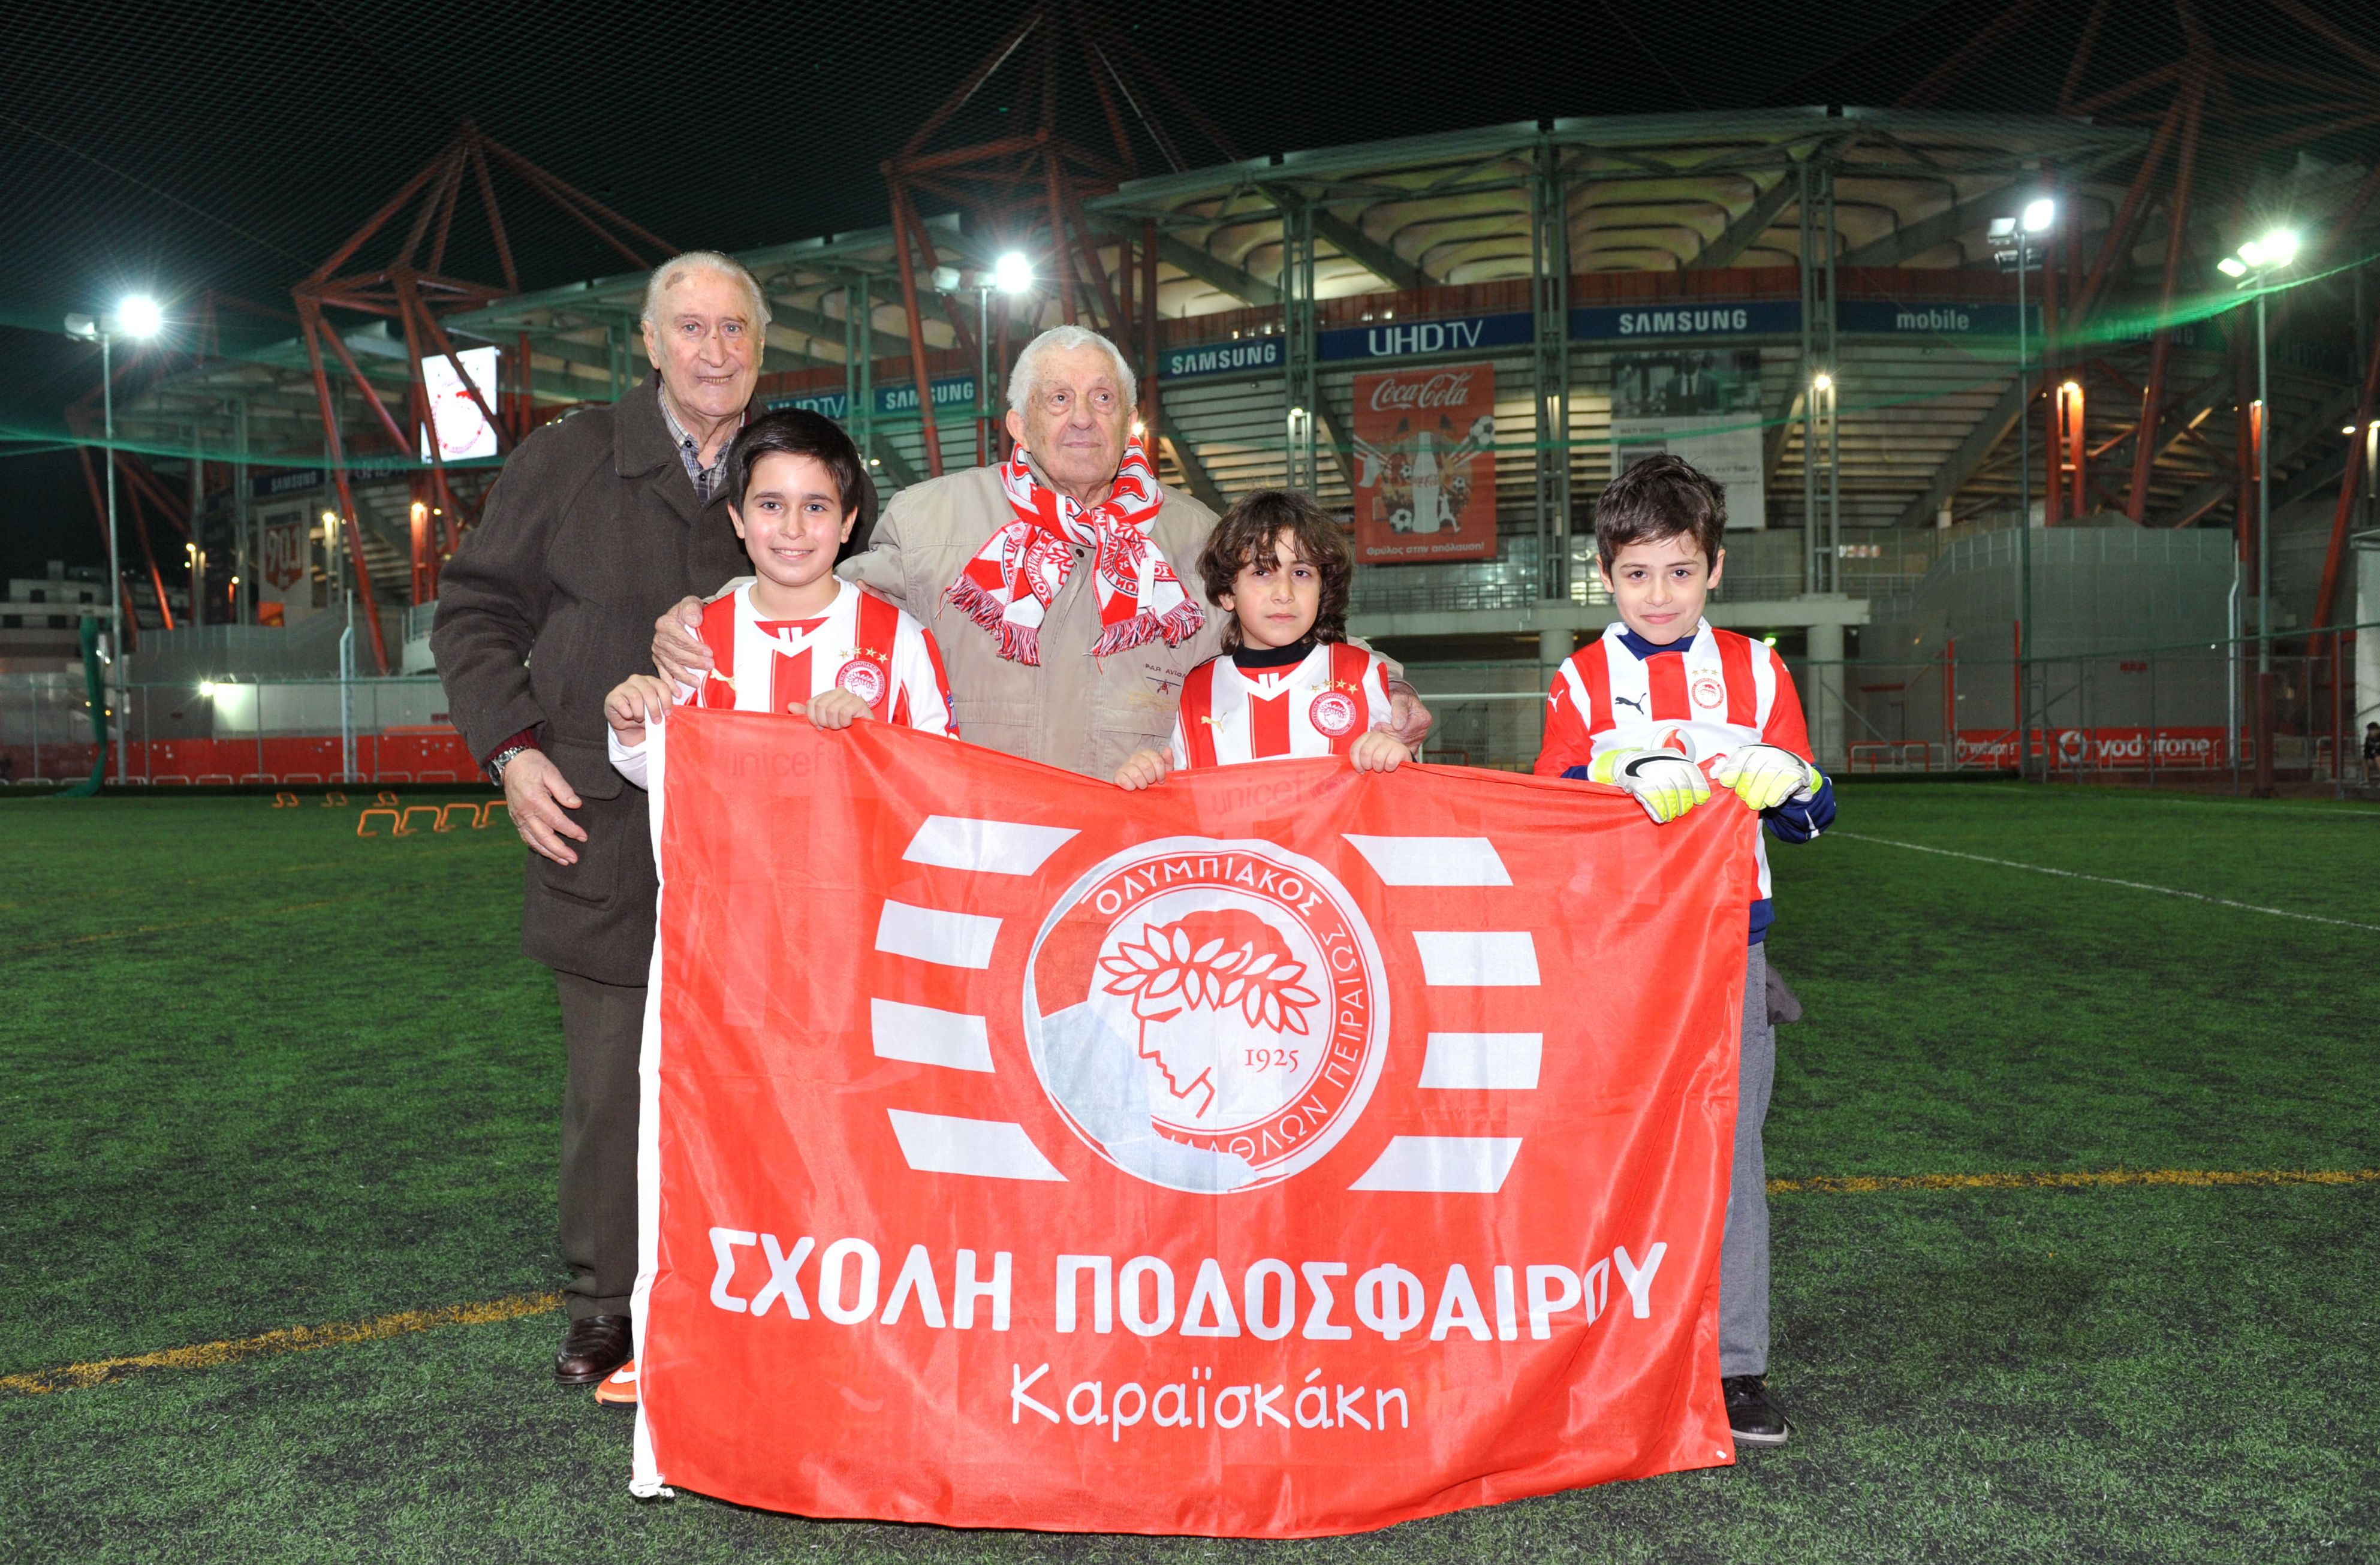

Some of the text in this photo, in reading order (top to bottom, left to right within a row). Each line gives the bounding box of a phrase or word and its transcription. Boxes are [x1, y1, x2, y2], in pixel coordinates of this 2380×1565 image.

[1619, 308, 1748, 334] SAMSUNG
[1896, 309, 1969, 331] mobile
[1171, 343, 1276, 375] SAMSUNG
[1145, 664, 1161, 672] PAR
[1096, 857, 1322, 916] ΟΛΥΜΠΙΑΚΟΣ
[1170, 923, 1364, 1162] ΘΛΩΝ ΠΕΙΡΑΙΩΣ
[1244, 1049, 1299, 1072] 1925
[709, 1226, 1667, 1341] ΣΧΟΛΗ ΠΟΔΟΣΦΑΙΡΟΥ
[1010, 1362, 1409, 1442] Καραϊσκάκη
